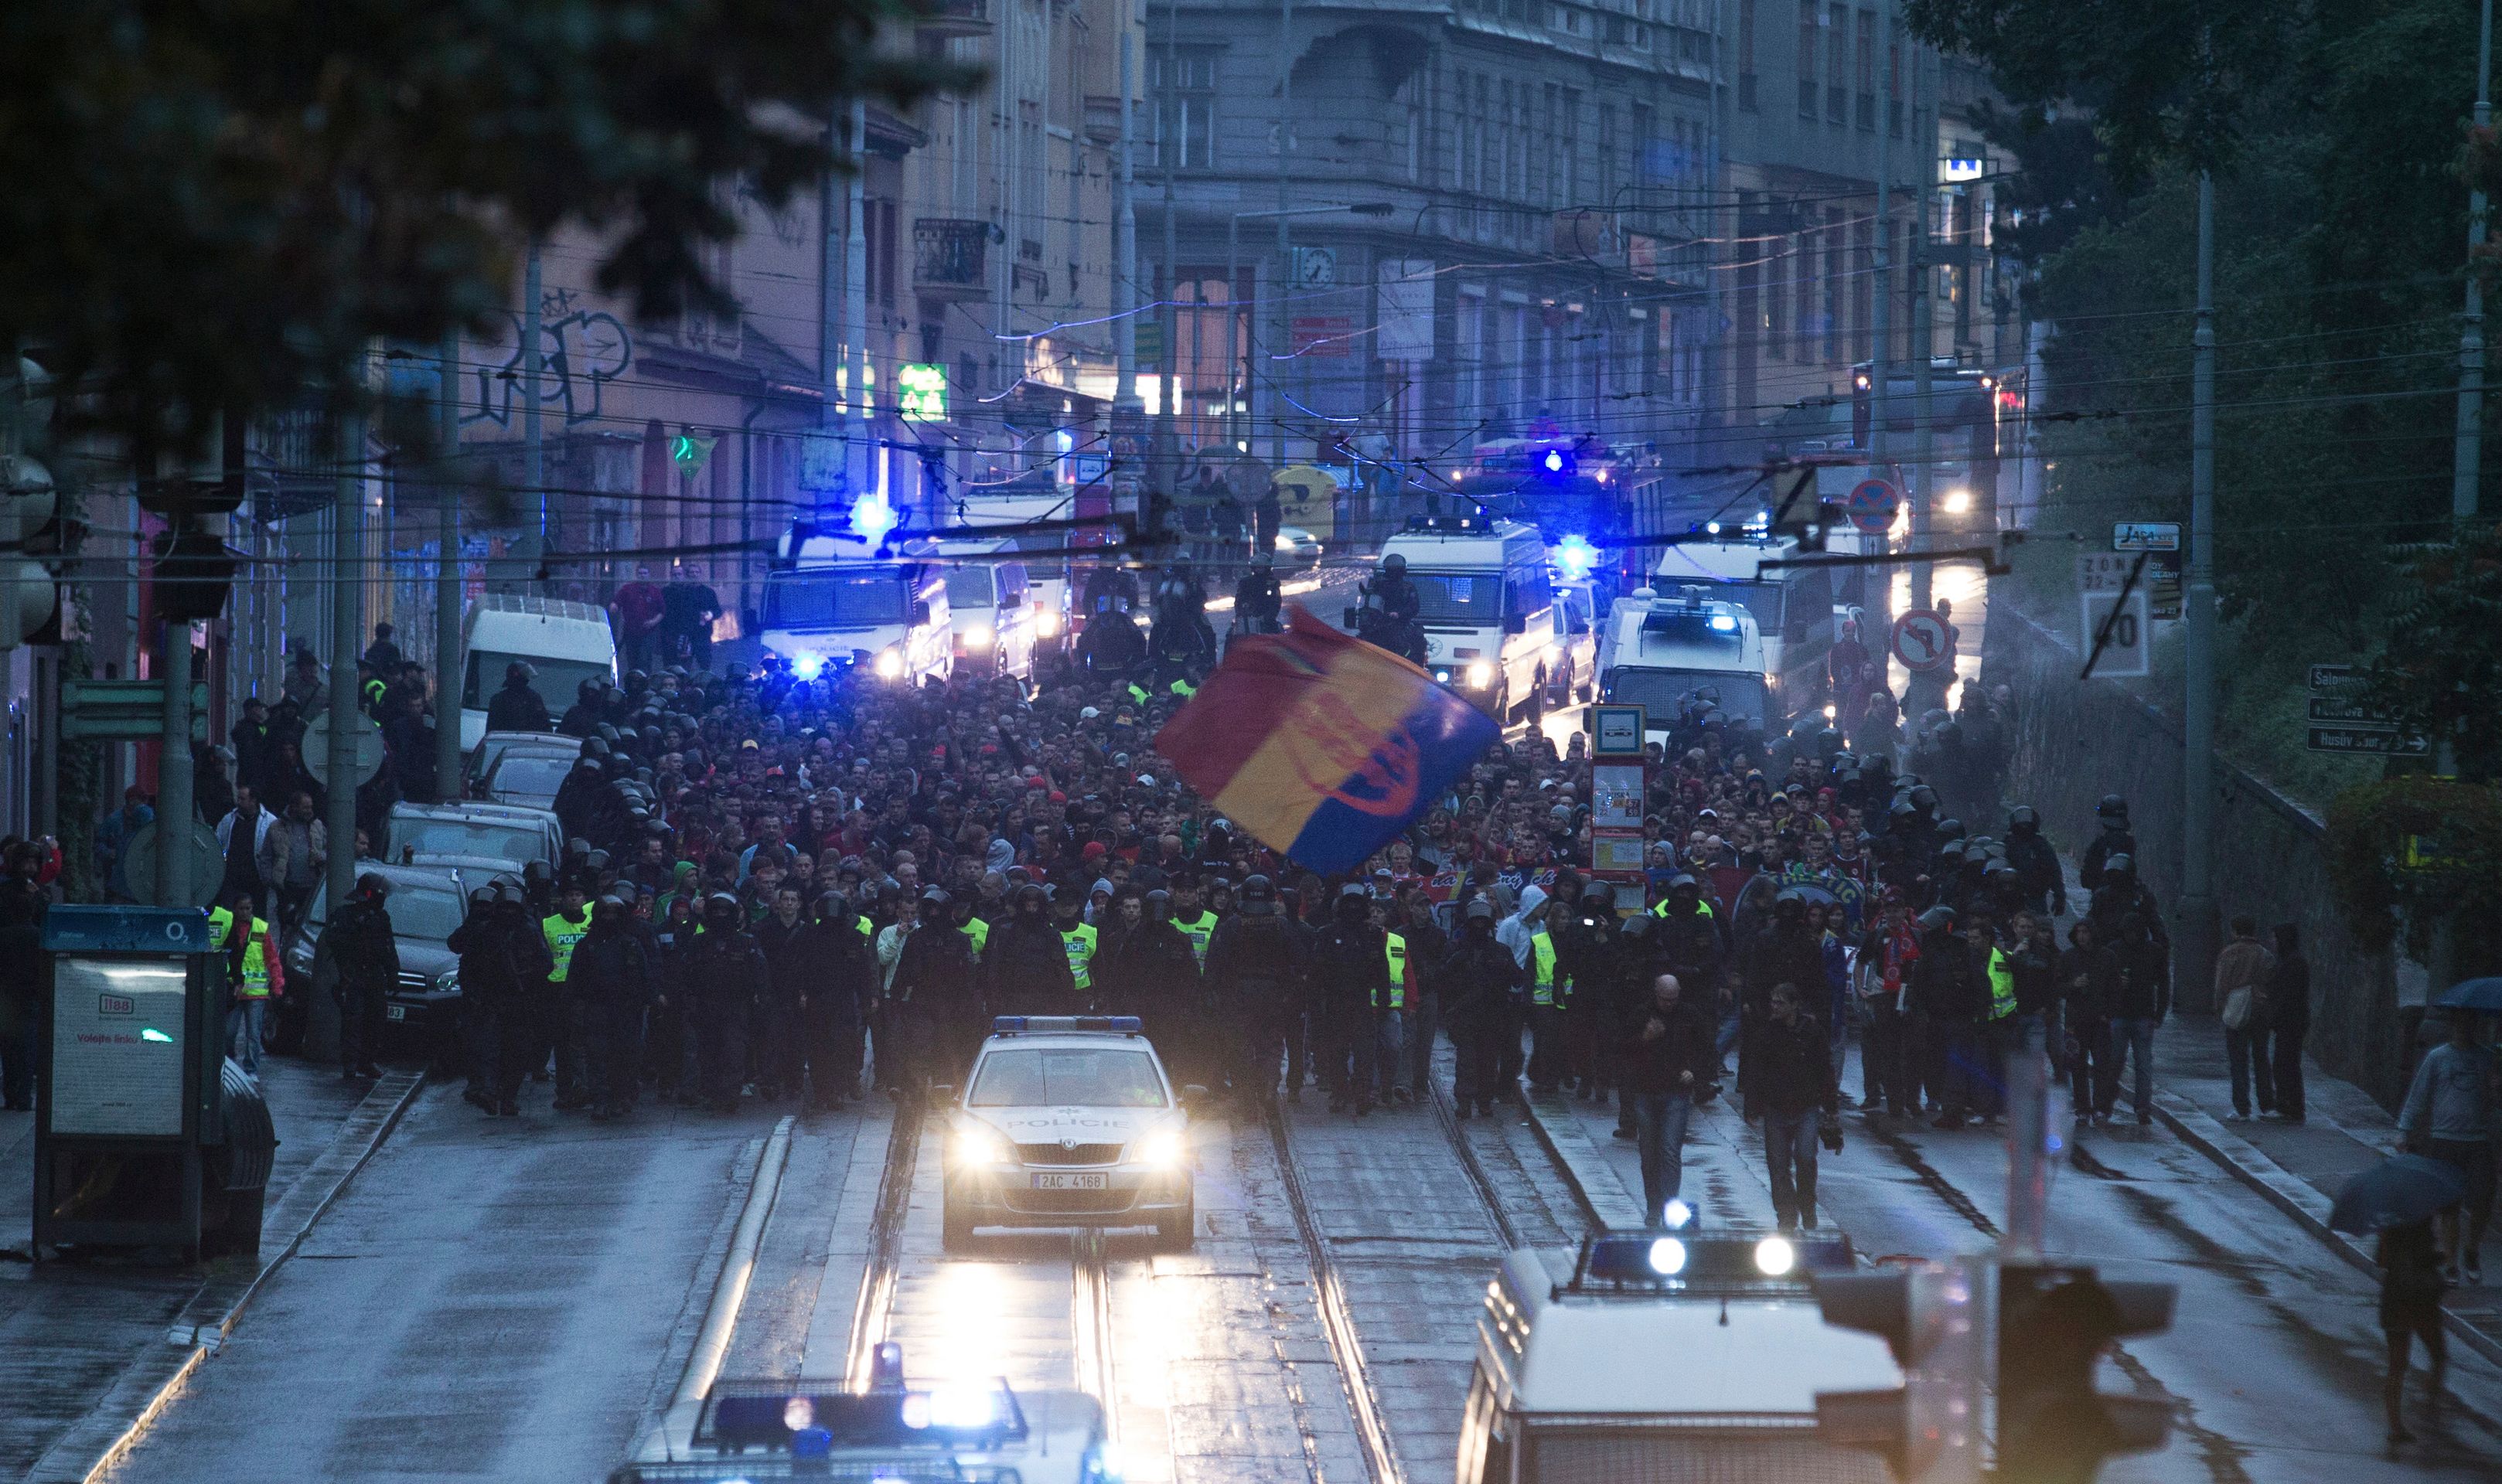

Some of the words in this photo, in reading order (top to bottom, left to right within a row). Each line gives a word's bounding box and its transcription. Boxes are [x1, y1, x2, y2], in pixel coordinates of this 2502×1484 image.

[1007, 1118, 1130, 1129] POLICIE
[1042, 1176, 1063, 1188] 2AC
[1072, 1176, 1101, 1188] 4168
